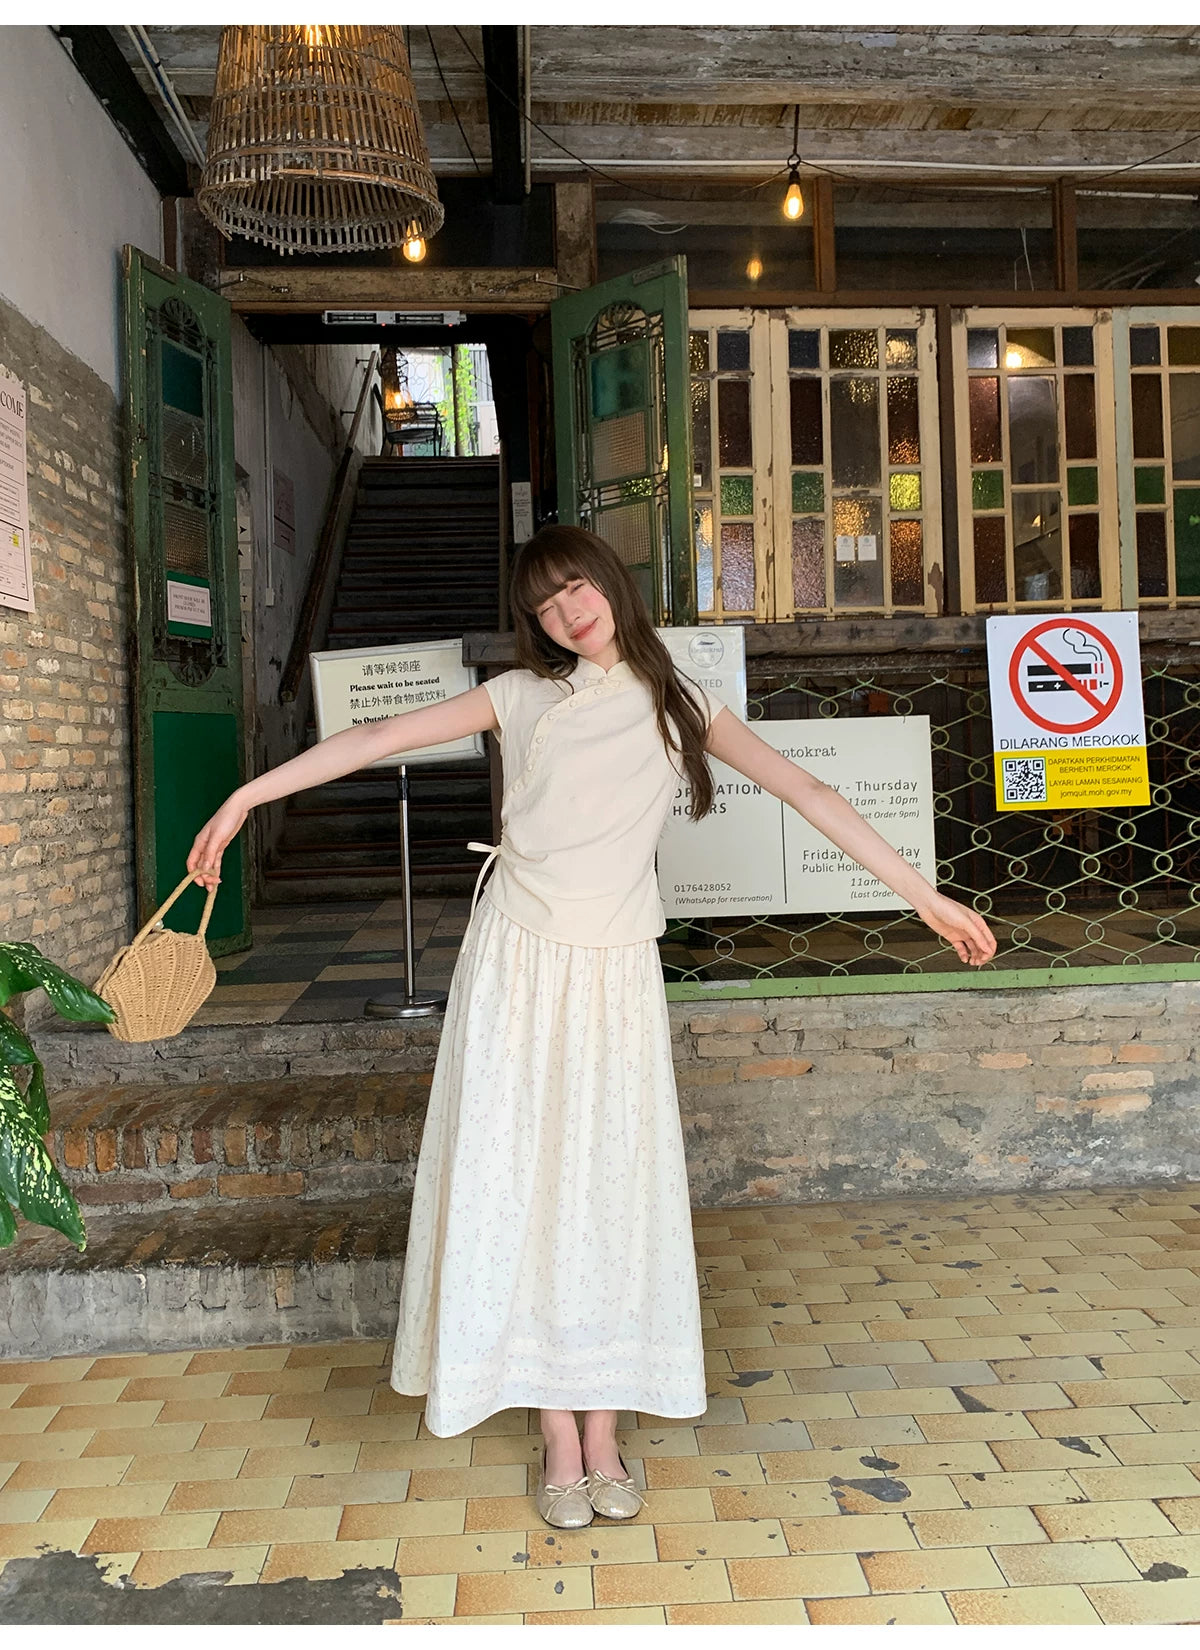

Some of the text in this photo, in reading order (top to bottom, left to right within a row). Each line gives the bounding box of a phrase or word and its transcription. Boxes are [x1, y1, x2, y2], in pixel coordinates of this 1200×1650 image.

[362, 660, 421, 676] 请等候领座
[350, 684, 375, 692] Please
[377, 682, 393, 690] wait
[405, 679, 413, 687] be
[350, 690, 446, 709] 禁止外带食物或饮料
[363, 713, 392, 723] Outsid
[1000, 735, 1140, 750] DILARANG MEROKOK
[776, 746, 837, 758] ptokrat
[1060, 765, 1094, 773] BERHENTI
[675, 784, 762, 798] OPATION
[856, 780, 917, 792] Thursday
[1060, 789, 1132, 798] jomquit.moh.gov.my
[889, 796, 918, 806] 10pm
[673, 803, 727, 816] HORS
[899, 810, 919, 818] 9pm)
[803, 849, 844, 861] Friday
[803, 864, 834, 873] Public
[851, 878, 880, 886] 11am
[674, 883, 731, 892] 0176428052
[851, 891, 869, 899] (Last
[676, 897, 716, 905] (WhatsApp
[717, 896, 728, 904] for
